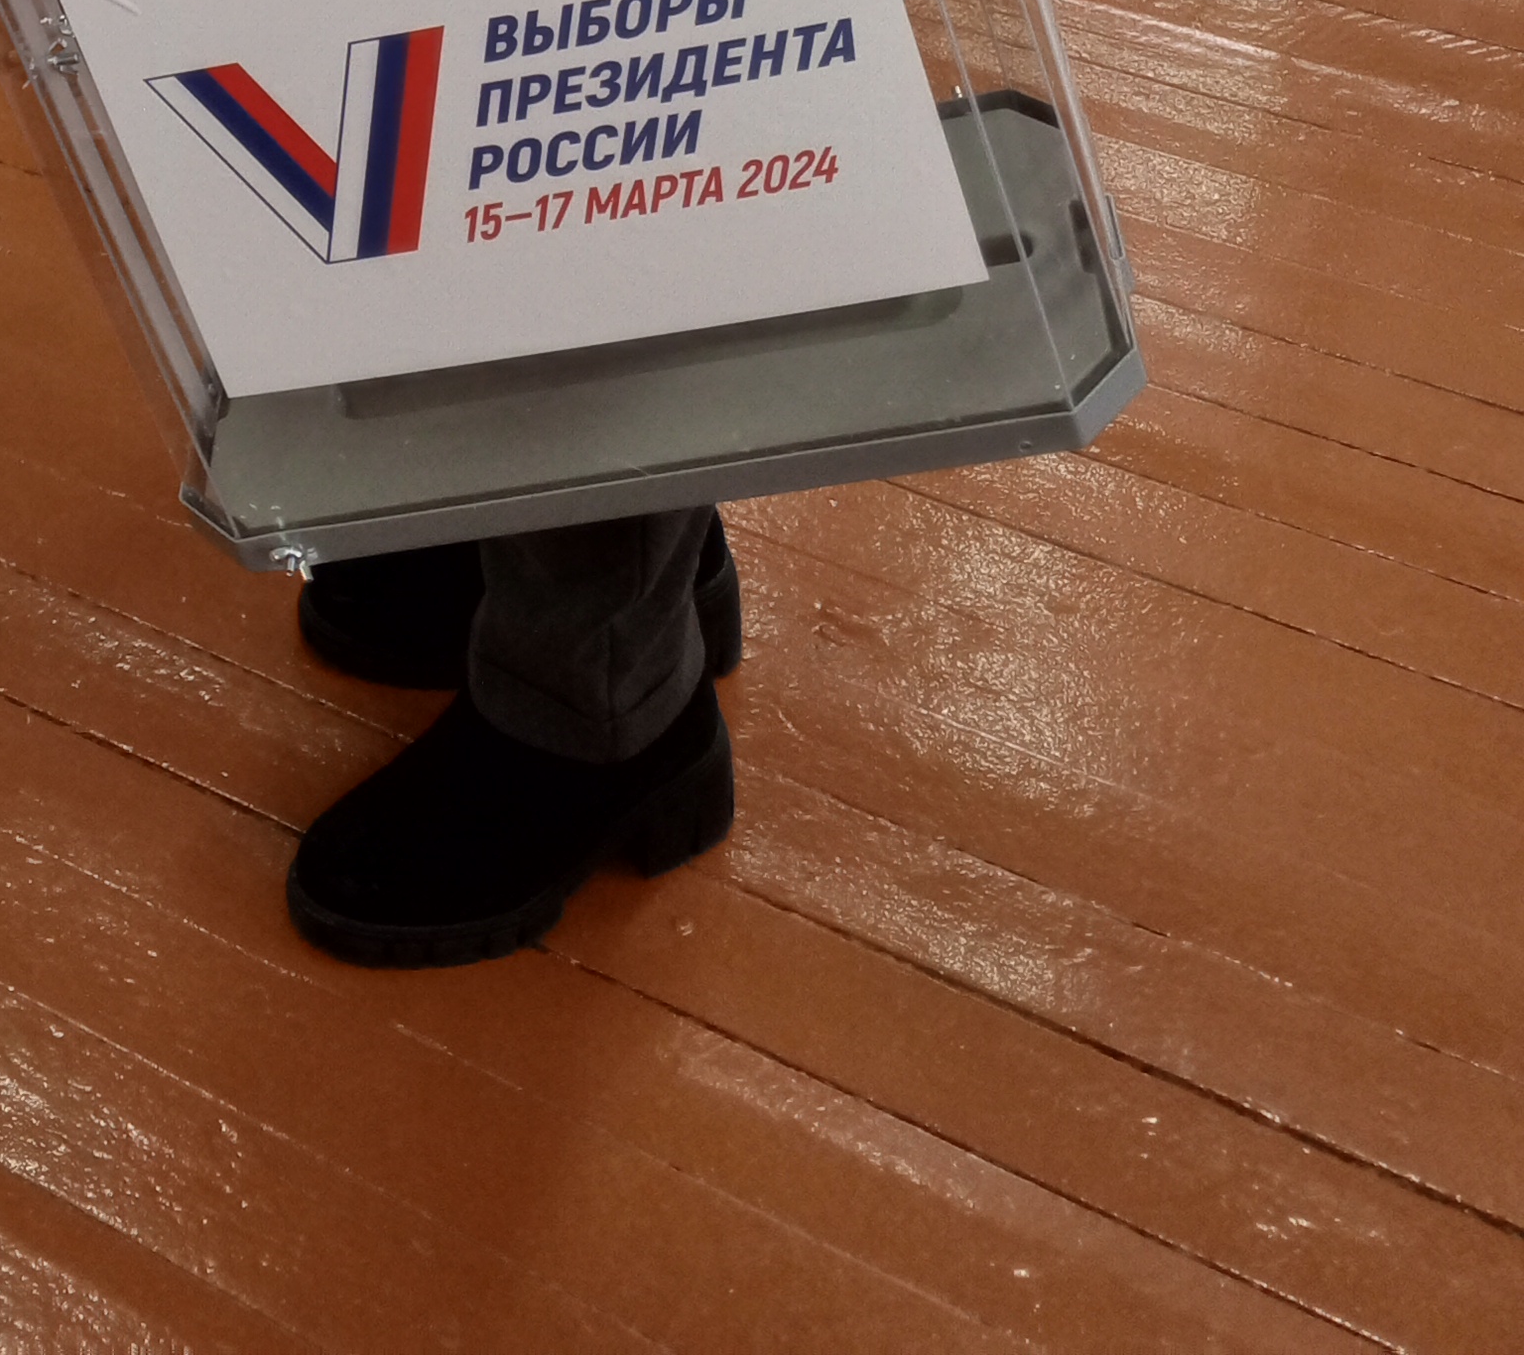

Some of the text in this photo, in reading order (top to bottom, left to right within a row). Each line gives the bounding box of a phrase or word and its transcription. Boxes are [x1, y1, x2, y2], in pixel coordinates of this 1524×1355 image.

[476, 17, 857, 127] ПРЕЗИДЕНТА
[468, 109, 702, 190] РОССИИ
[584, 166, 724, 224] МАРТА
[736, 146, 839, 199] 2024
